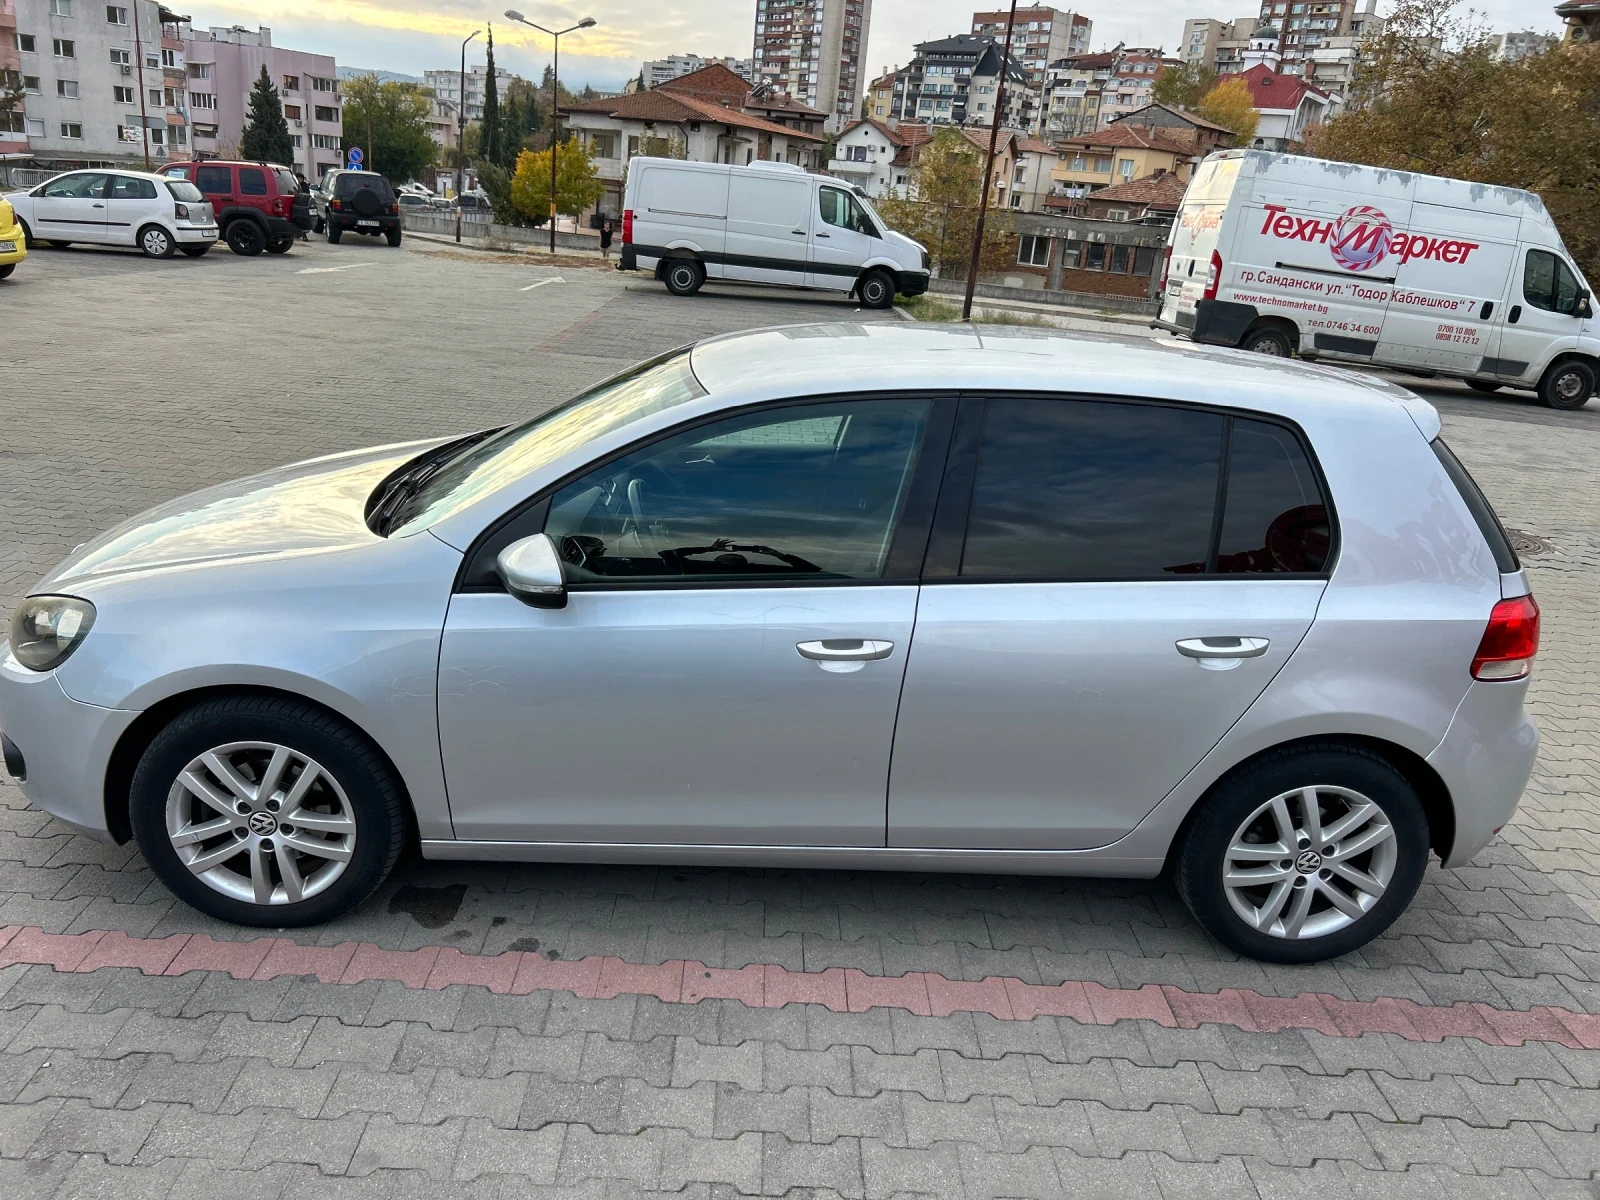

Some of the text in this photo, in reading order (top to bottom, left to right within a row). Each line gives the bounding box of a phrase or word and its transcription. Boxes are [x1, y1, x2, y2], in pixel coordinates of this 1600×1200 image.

[1240, 270, 1323, 291] гр.Сандански
[1325, 283, 1344, 295] ул.
[1467, 301, 1476, 312] 7
[1233, 293, 1328, 314] www.technomarket.bg
[1308, 319, 1380, 335] тел.0746 34 600
[1437, 324, 1476, 336] 0700 10 800
[1435, 332, 1452, 341] 0898
[1453, 334, 1461, 342] 12
[1471, 337, 1480, 345] 12
